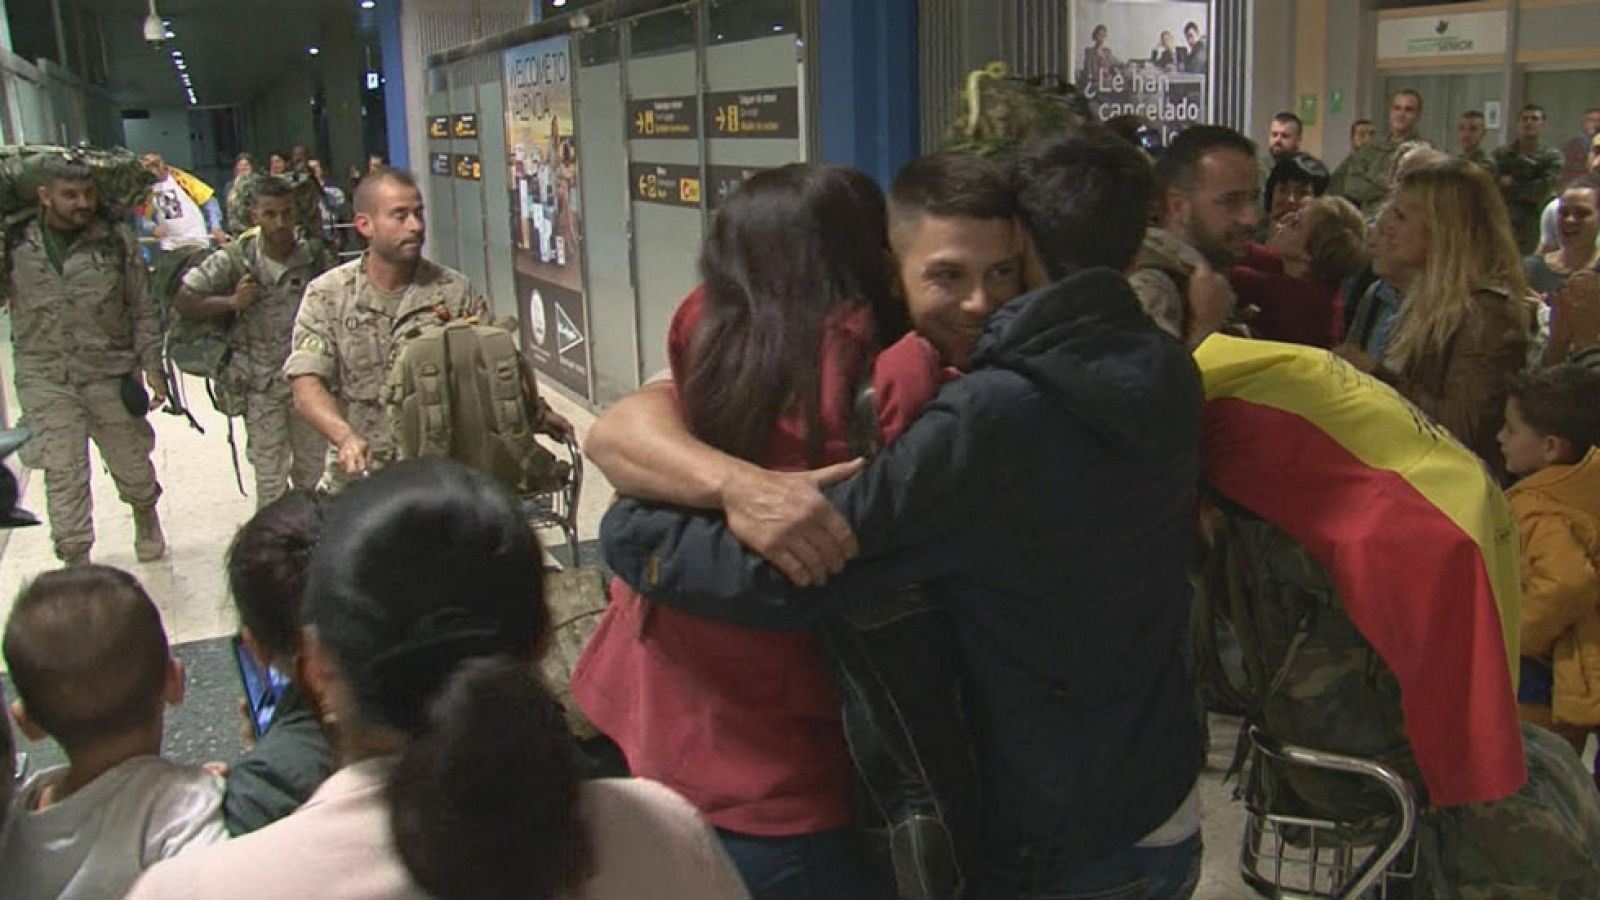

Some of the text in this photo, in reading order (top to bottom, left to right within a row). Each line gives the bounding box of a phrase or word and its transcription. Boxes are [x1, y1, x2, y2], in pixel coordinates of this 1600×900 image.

[1084, 63, 1170, 99] ¿Le han
[1098, 97, 1199, 121] cancelado
